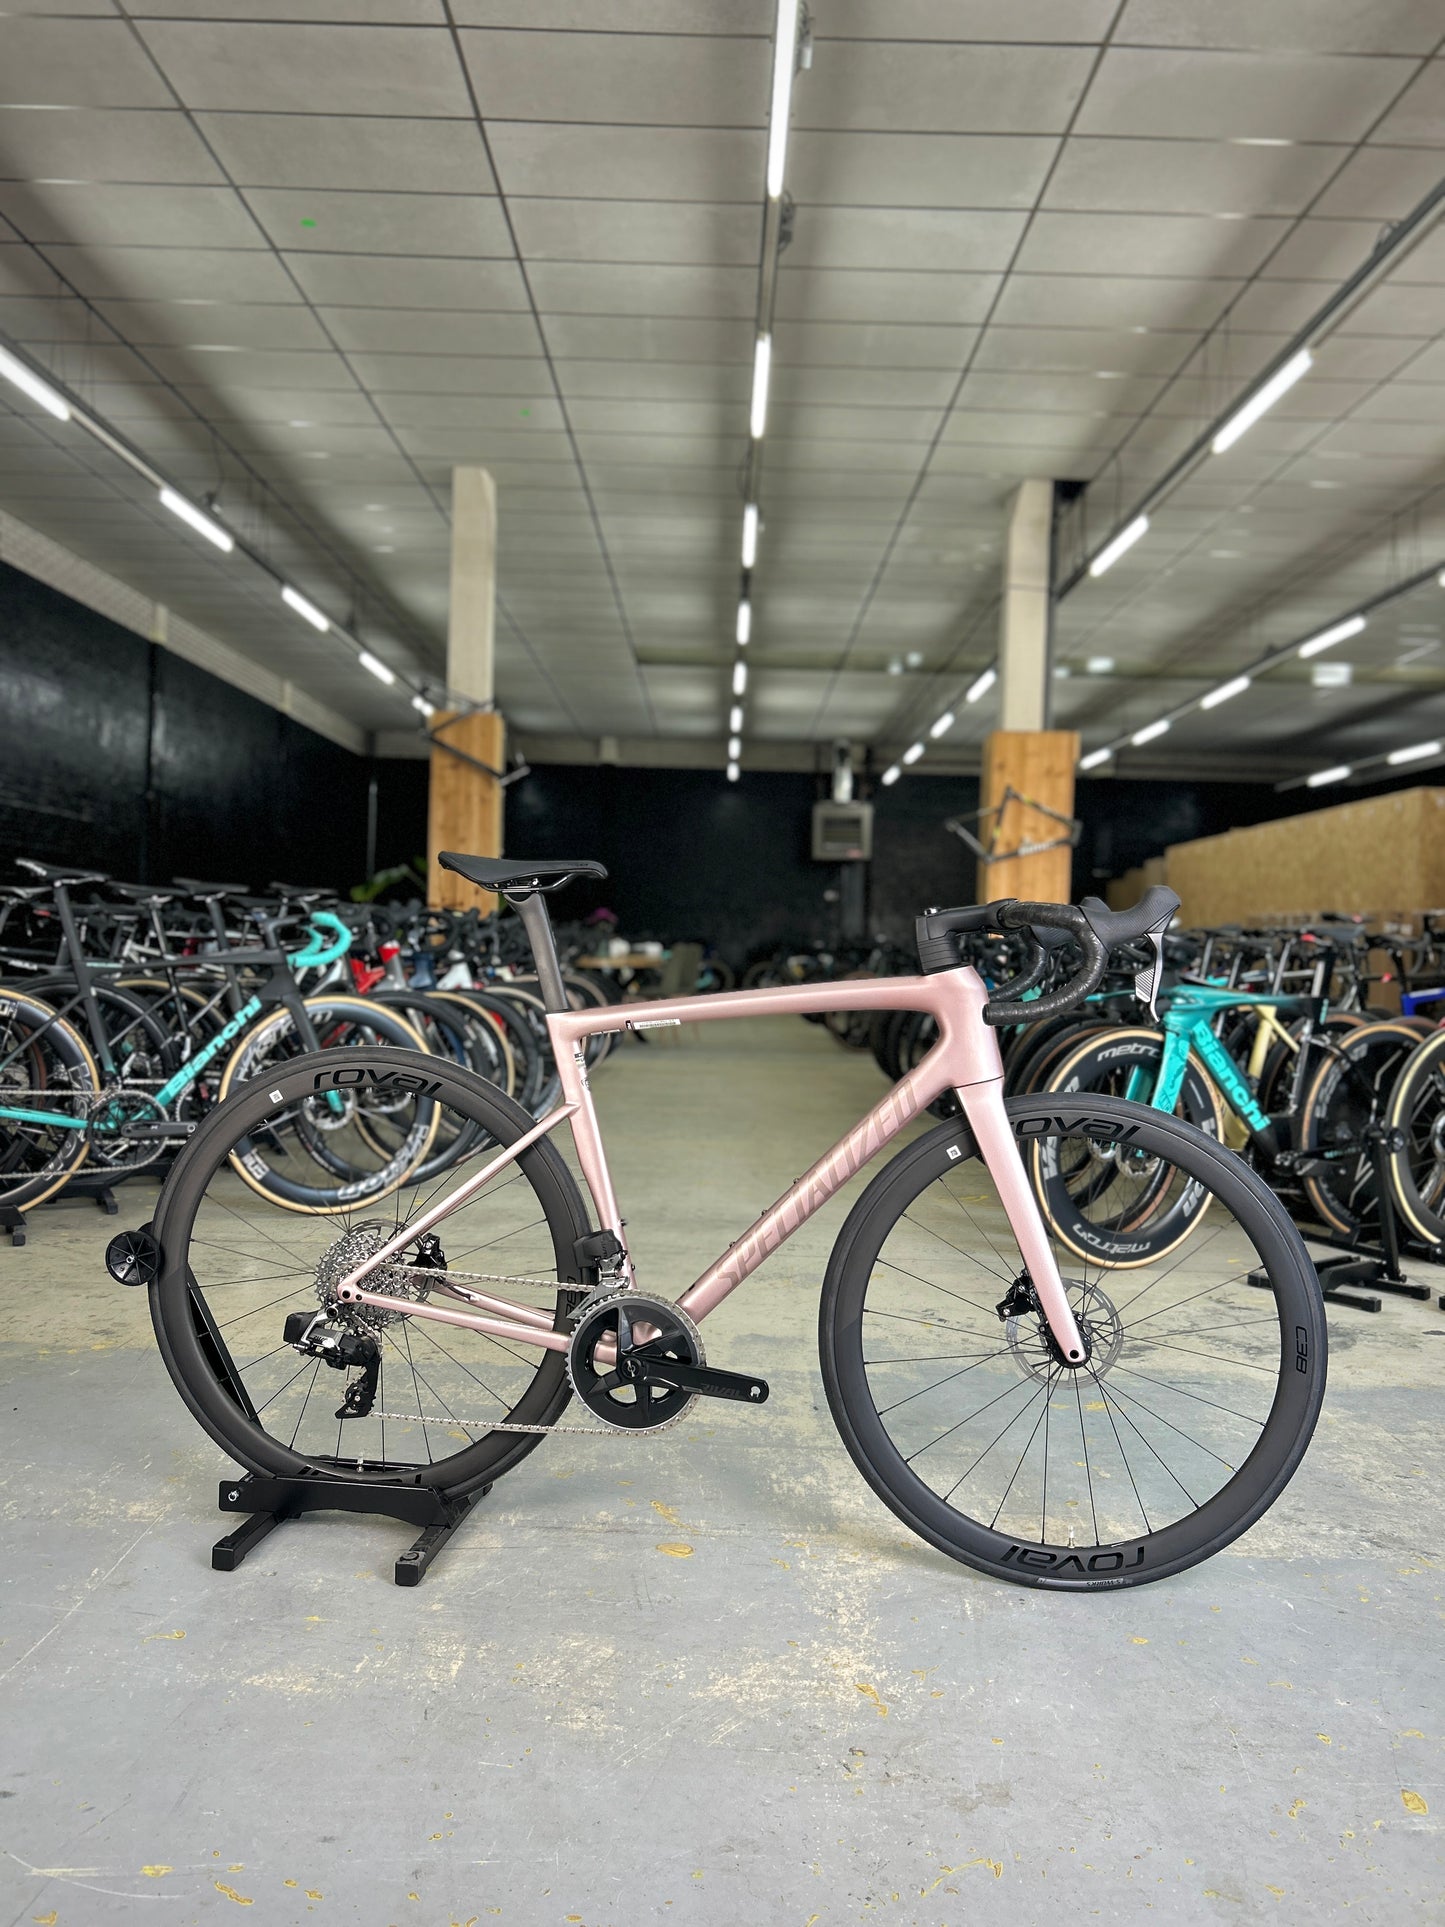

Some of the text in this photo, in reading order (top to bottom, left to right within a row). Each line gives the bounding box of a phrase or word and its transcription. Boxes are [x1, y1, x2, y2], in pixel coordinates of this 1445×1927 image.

[165, 994, 262, 1097] Bianchi
[314, 1068, 444, 1096] roval
[1192, 1019, 1271, 1132] Bianchi
[1010, 1116, 1142, 1141] oval
[717, 1079, 918, 1289] SPECIALIZED
[1295, 1325, 1308, 1375] C38
[1001, 1545, 1145, 1573] roval
